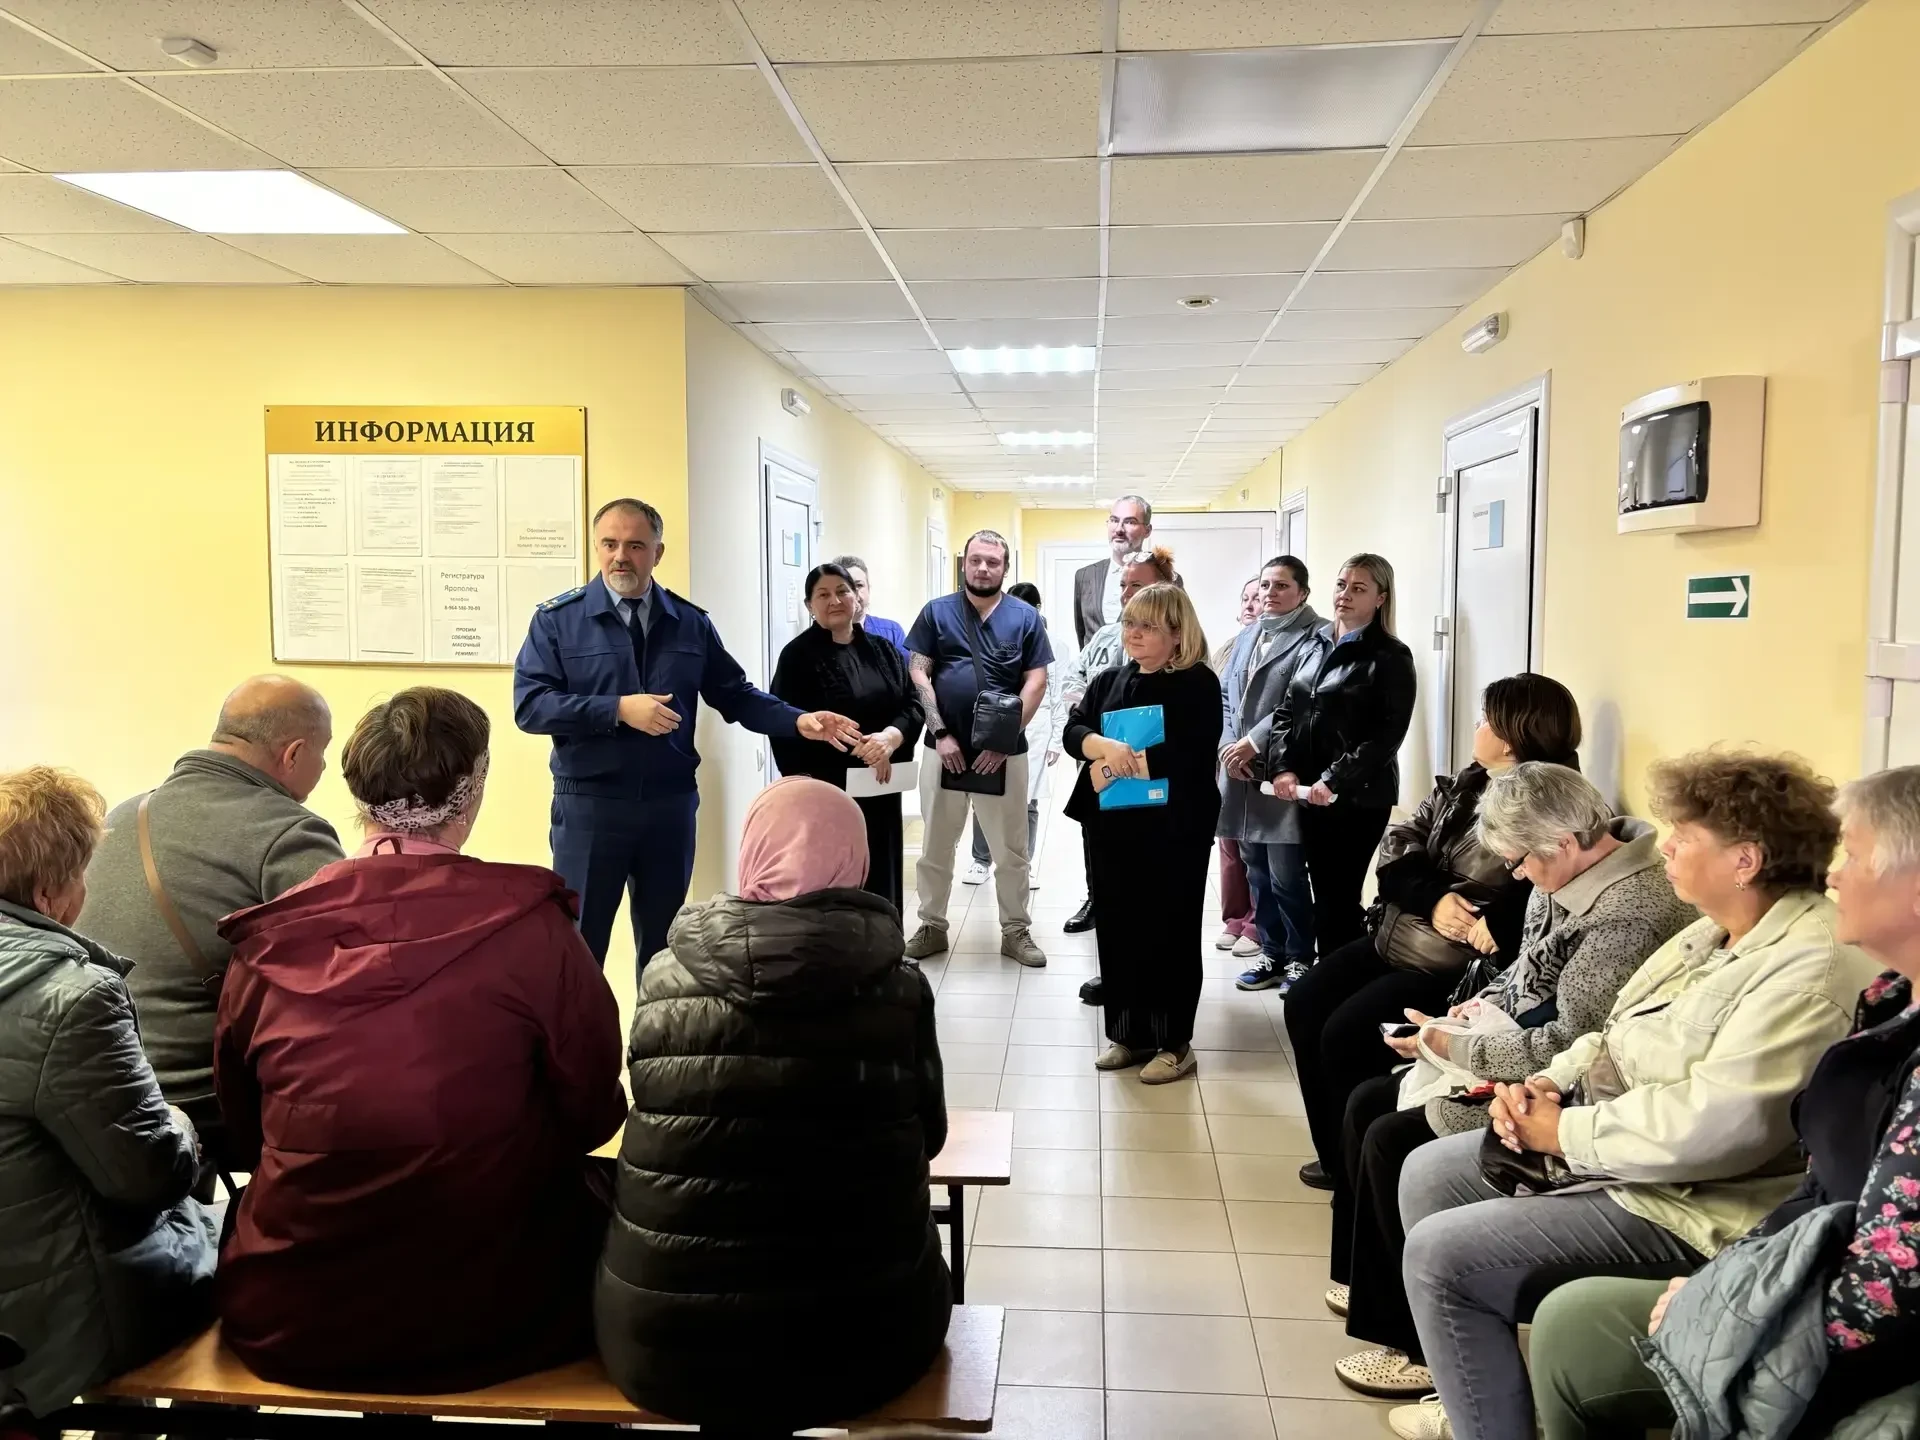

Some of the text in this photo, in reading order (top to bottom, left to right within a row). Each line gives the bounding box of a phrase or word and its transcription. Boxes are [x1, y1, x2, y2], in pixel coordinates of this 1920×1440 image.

[315, 420, 535, 446] ИНФОРМАЦИЯ
[440, 572, 485, 580] Регистратура
[444, 584, 479, 592] Ярополец
